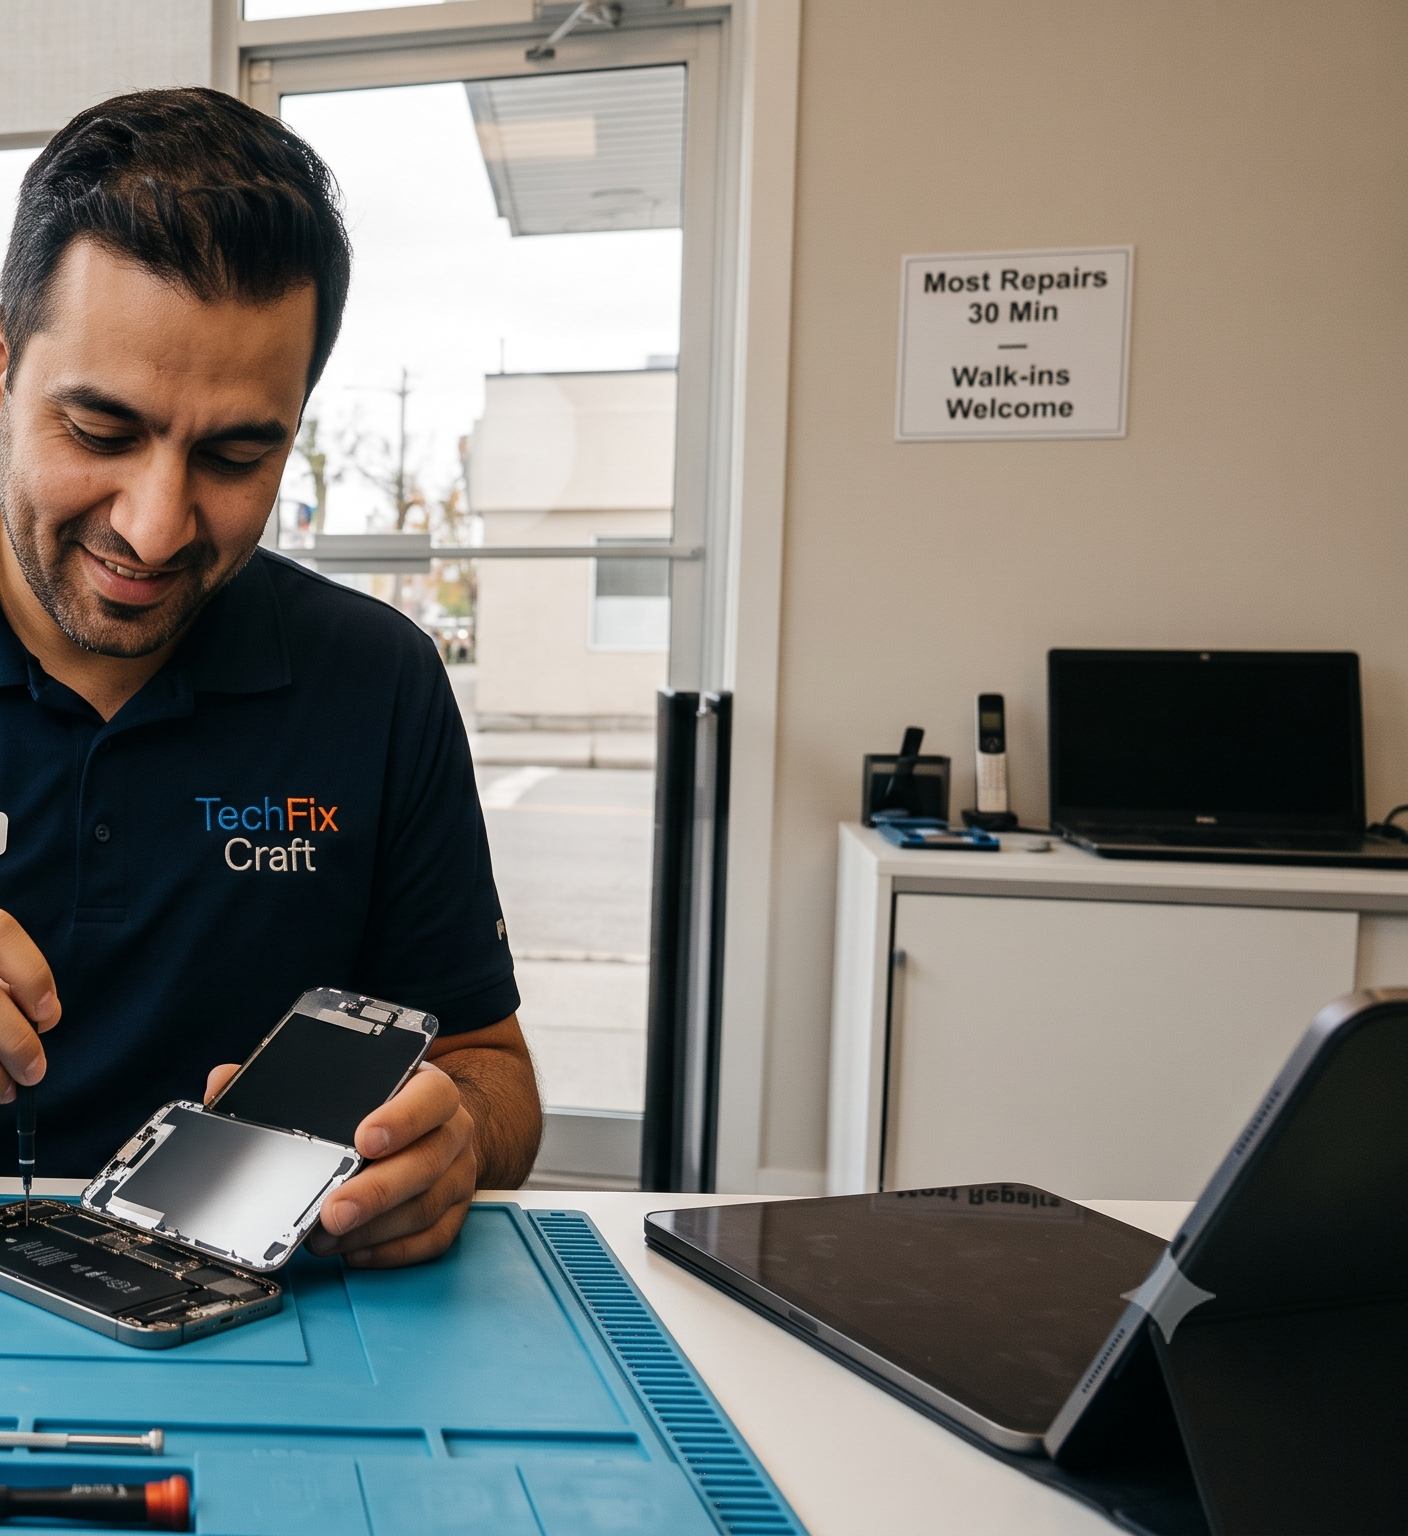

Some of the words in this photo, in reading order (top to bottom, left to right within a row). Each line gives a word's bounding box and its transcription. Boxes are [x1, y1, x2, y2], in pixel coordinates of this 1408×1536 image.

[924, 271, 990, 293] Most
[1000, 267, 1108, 294] Repairs
[968, 302, 999, 324] 30
[1009, 301, 1059, 323] Min
[952, 365, 1070, 387] Walk-ins
[946, 397, 1074, 419] Welcome
[195, 796, 340, 832] TechFix
[224, 838, 317, 872] Craft
